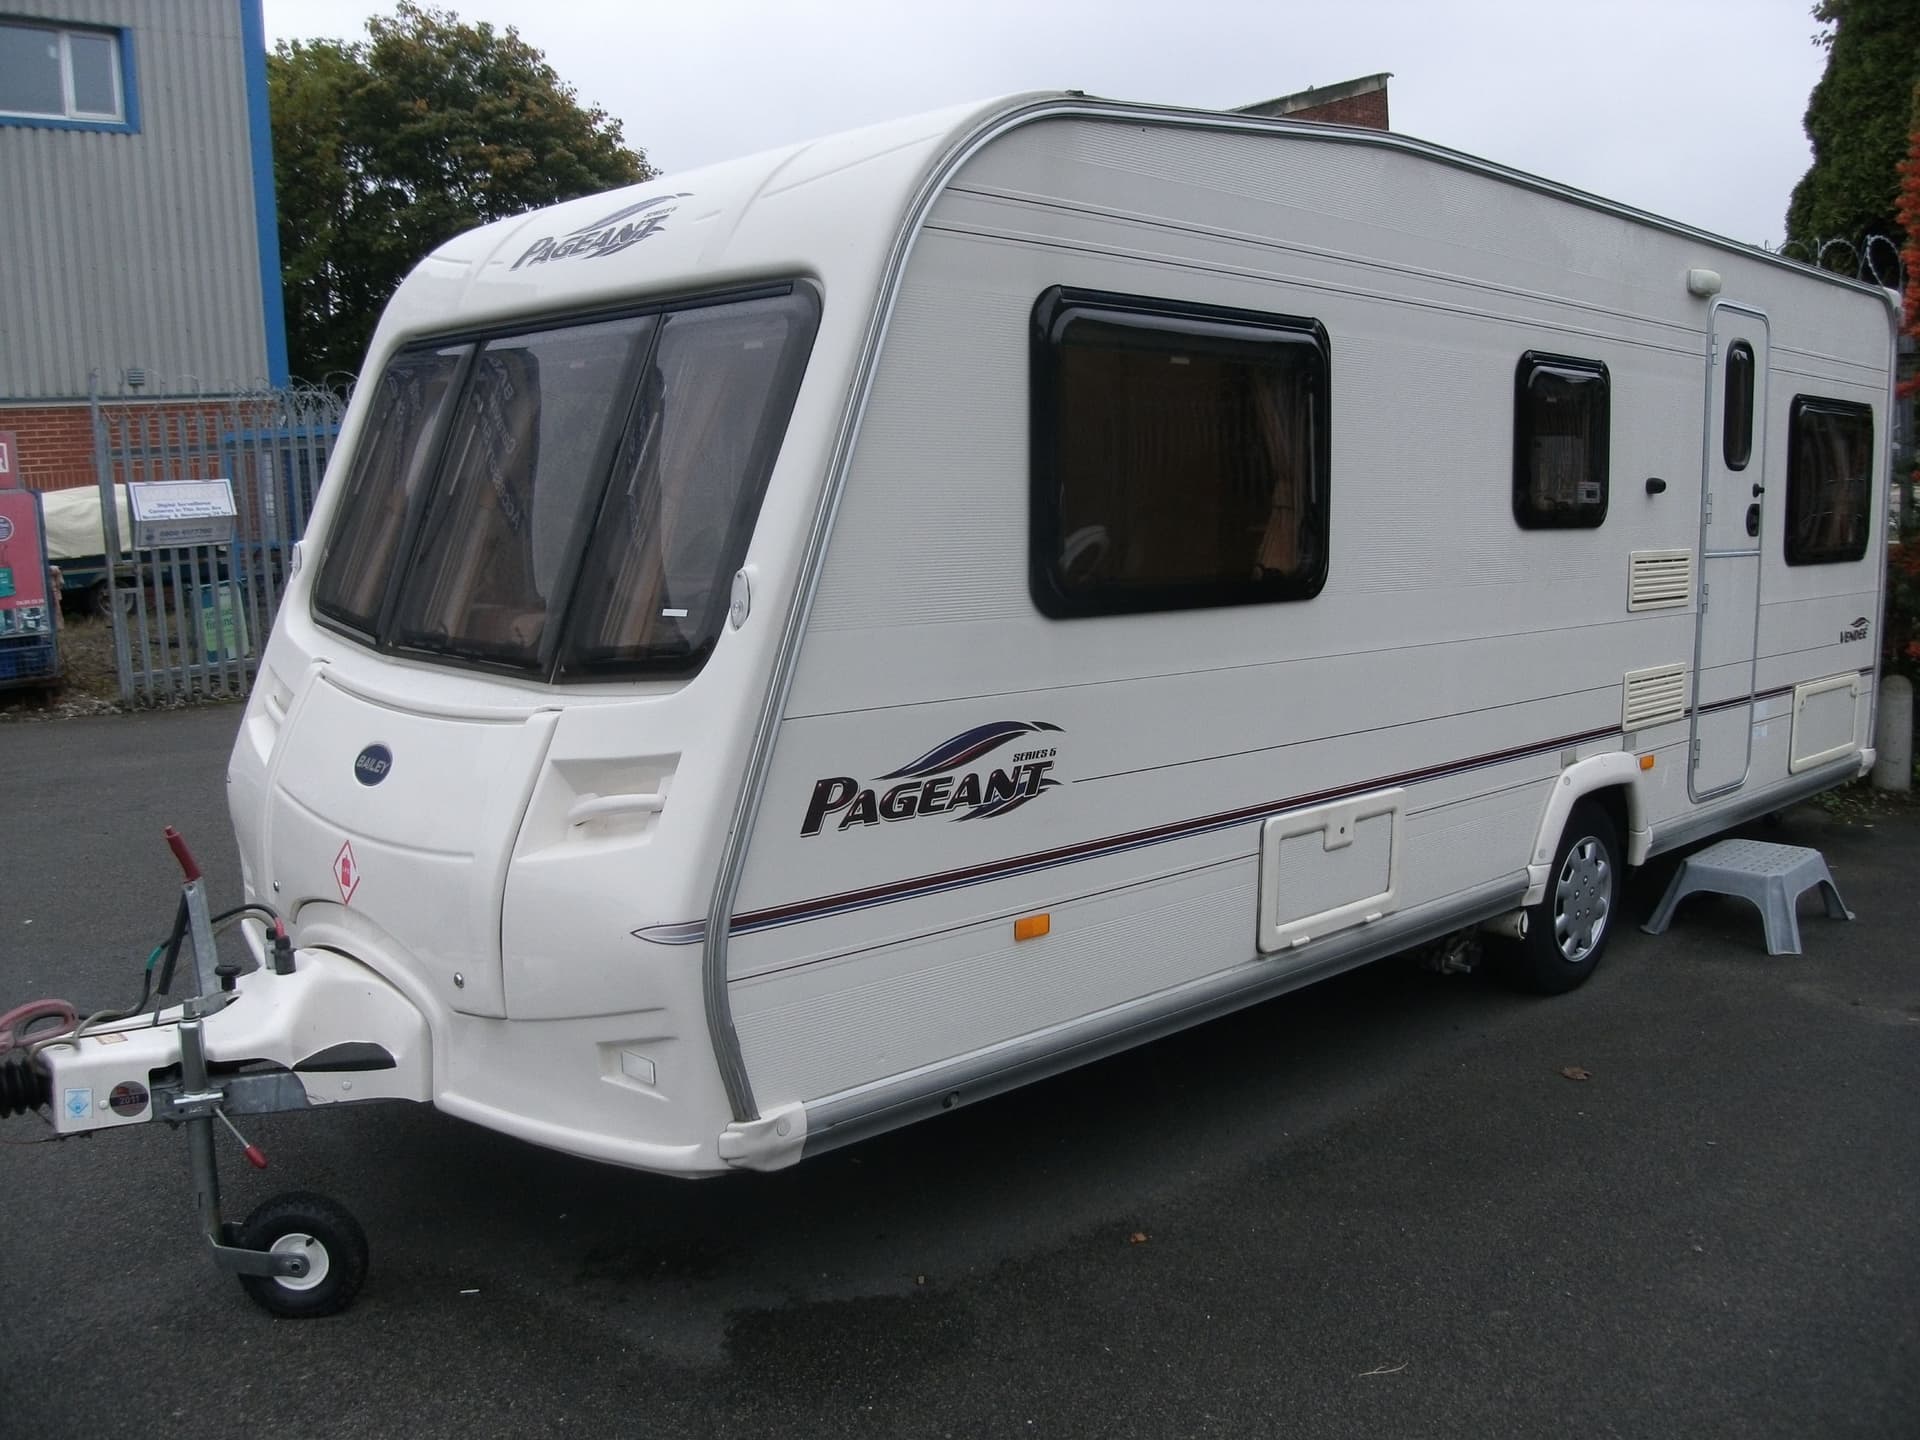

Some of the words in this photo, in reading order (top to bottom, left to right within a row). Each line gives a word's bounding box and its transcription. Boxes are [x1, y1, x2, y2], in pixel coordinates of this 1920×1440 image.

[509, 214, 670, 272] PAGEANT
[356, 754, 390, 774] BAILEY
[1013, 749, 1048, 763] SERIES
[1049, 747, 1057, 757] 5
[800, 760, 1056, 838] PAGEANT
